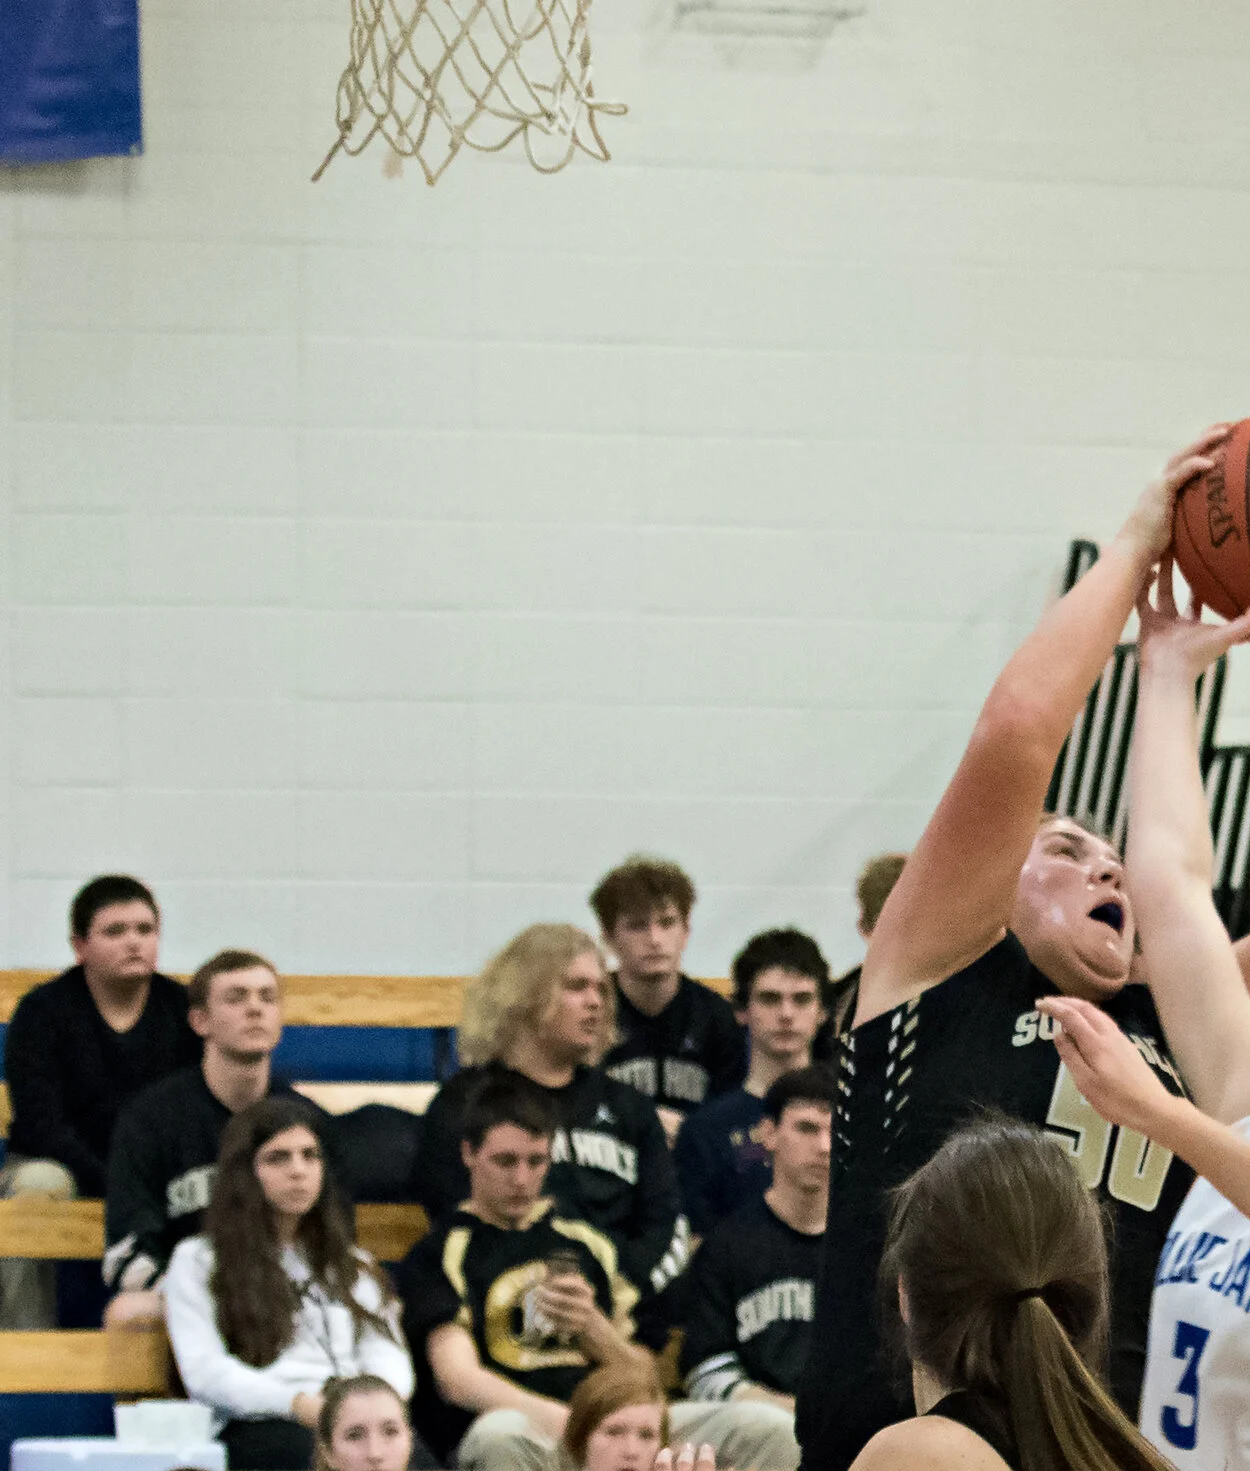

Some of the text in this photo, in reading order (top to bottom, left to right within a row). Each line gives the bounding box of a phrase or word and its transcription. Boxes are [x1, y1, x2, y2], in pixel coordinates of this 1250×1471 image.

[1205, 453, 1241, 549] SPAL
[1154, 1231, 1228, 1287] LUE
[736, 1278, 815, 1342] SOUTH
[1160, 1320, 1210, 1450] 3
